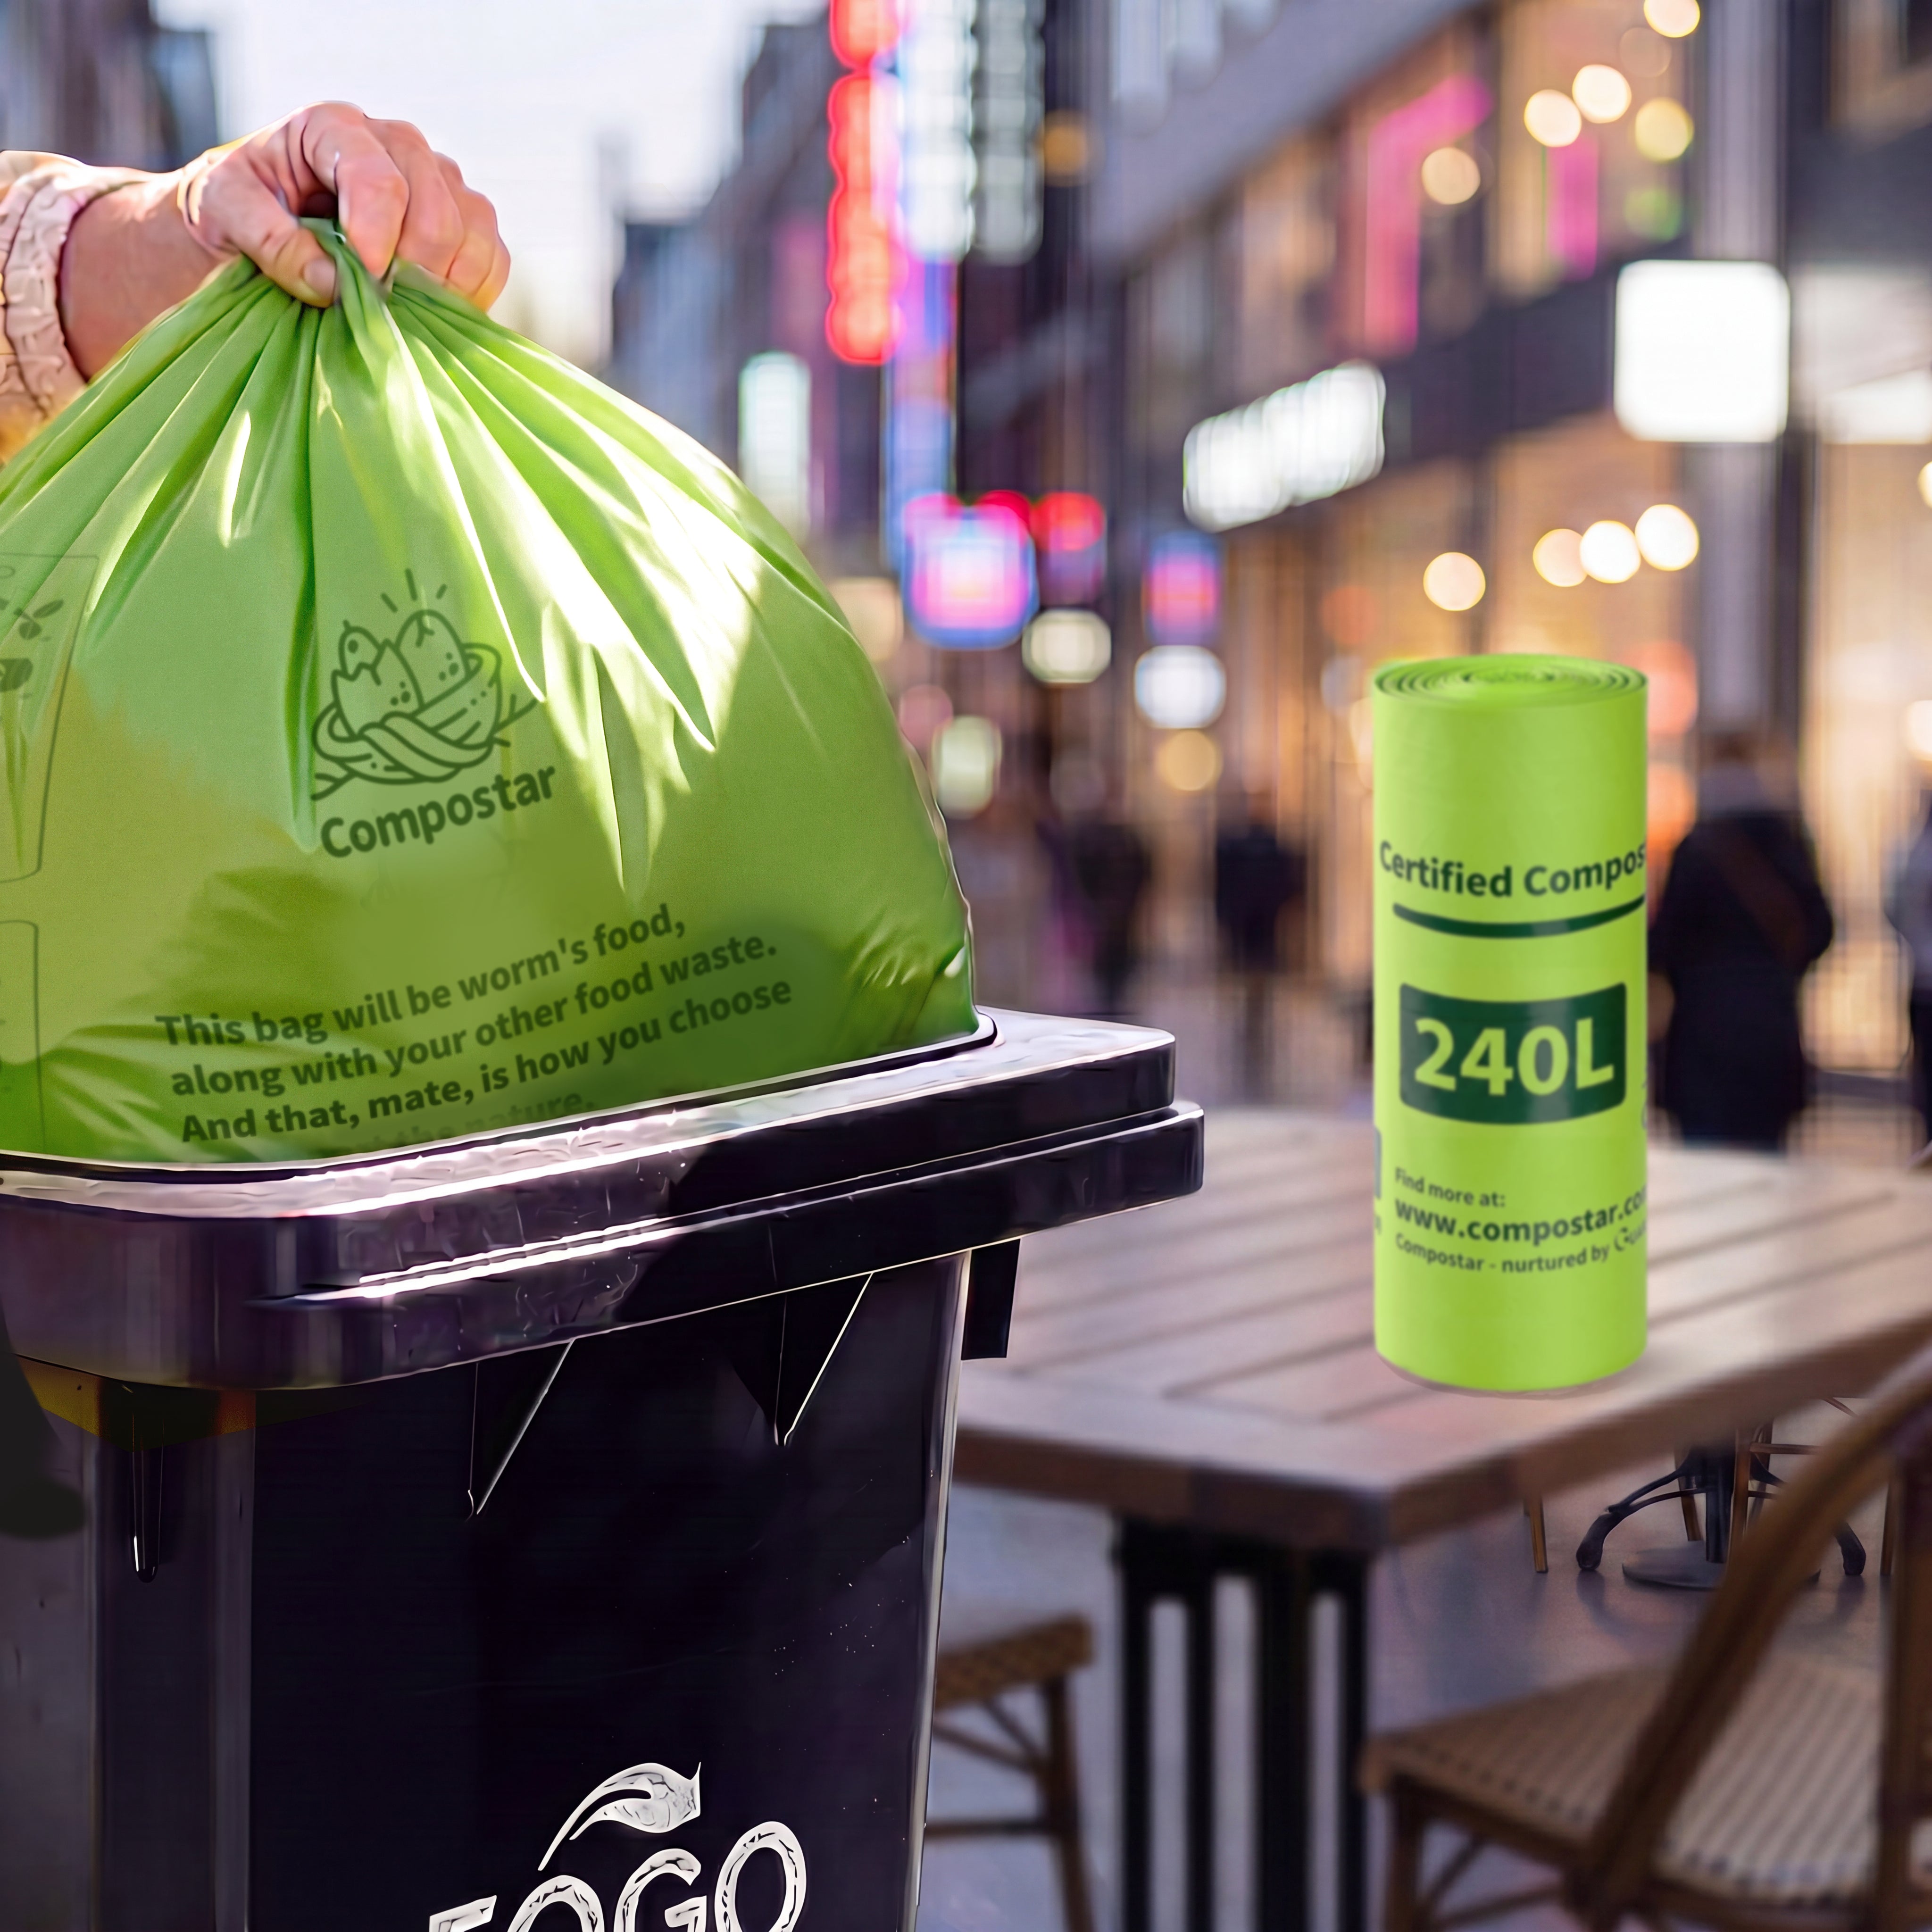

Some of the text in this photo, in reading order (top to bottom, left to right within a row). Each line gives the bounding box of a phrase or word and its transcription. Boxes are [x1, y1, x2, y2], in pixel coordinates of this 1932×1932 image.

[320, 765, 556, 858] Compostar
[1380, 840, 1513, 898] Certified
[154, 904, 685, 1046] This bag will be worm's food,
[171, 936, 776, 1097] along with your other food waste.
[182, 982, 791, 1144] And that, mate, is how you choose
[1414, 1017, 1614, 1096] 240L
[1394, 1186, 1646, 1247] www.compostar.co
[1395, 1167, 1505, 1208] Find more at:
[1396, 1232, 1484, 1271] Compostar
[1501, 1248, 1587, 1273] nurtured
[1591, 1243, 1610, 1263] by
